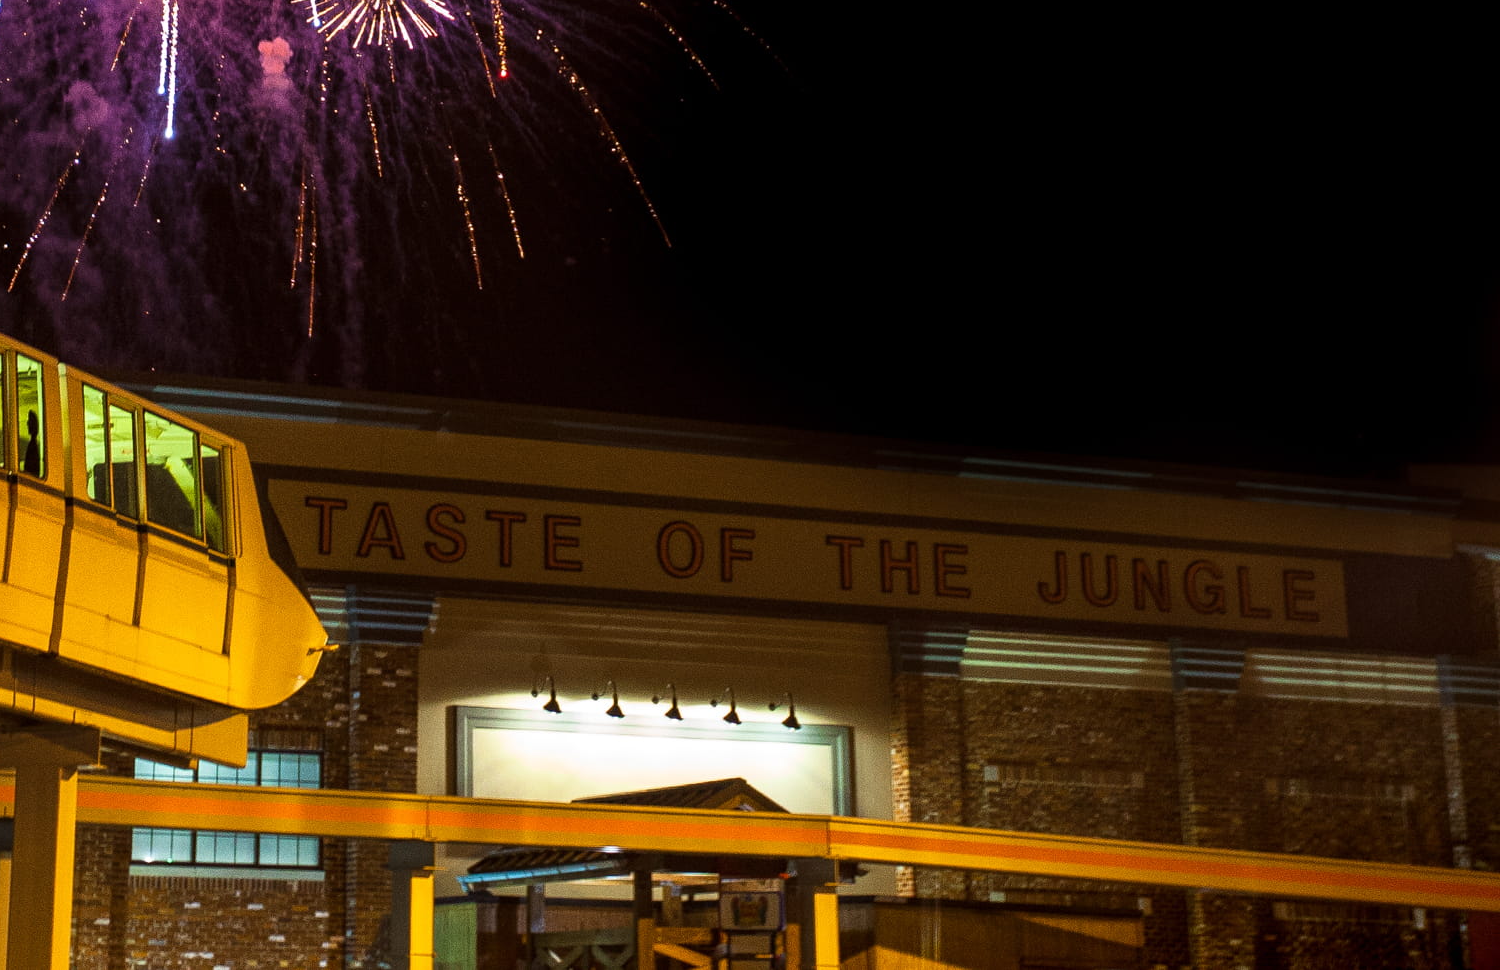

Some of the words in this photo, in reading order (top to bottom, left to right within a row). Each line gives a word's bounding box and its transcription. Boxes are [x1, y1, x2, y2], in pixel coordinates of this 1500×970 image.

[305, 497, 583, 572] TASTE
[656, 521, 755, 582] OF
[827, 536, 971, 598] THE
[1038, 551, 1318, 621] JUNGLE
